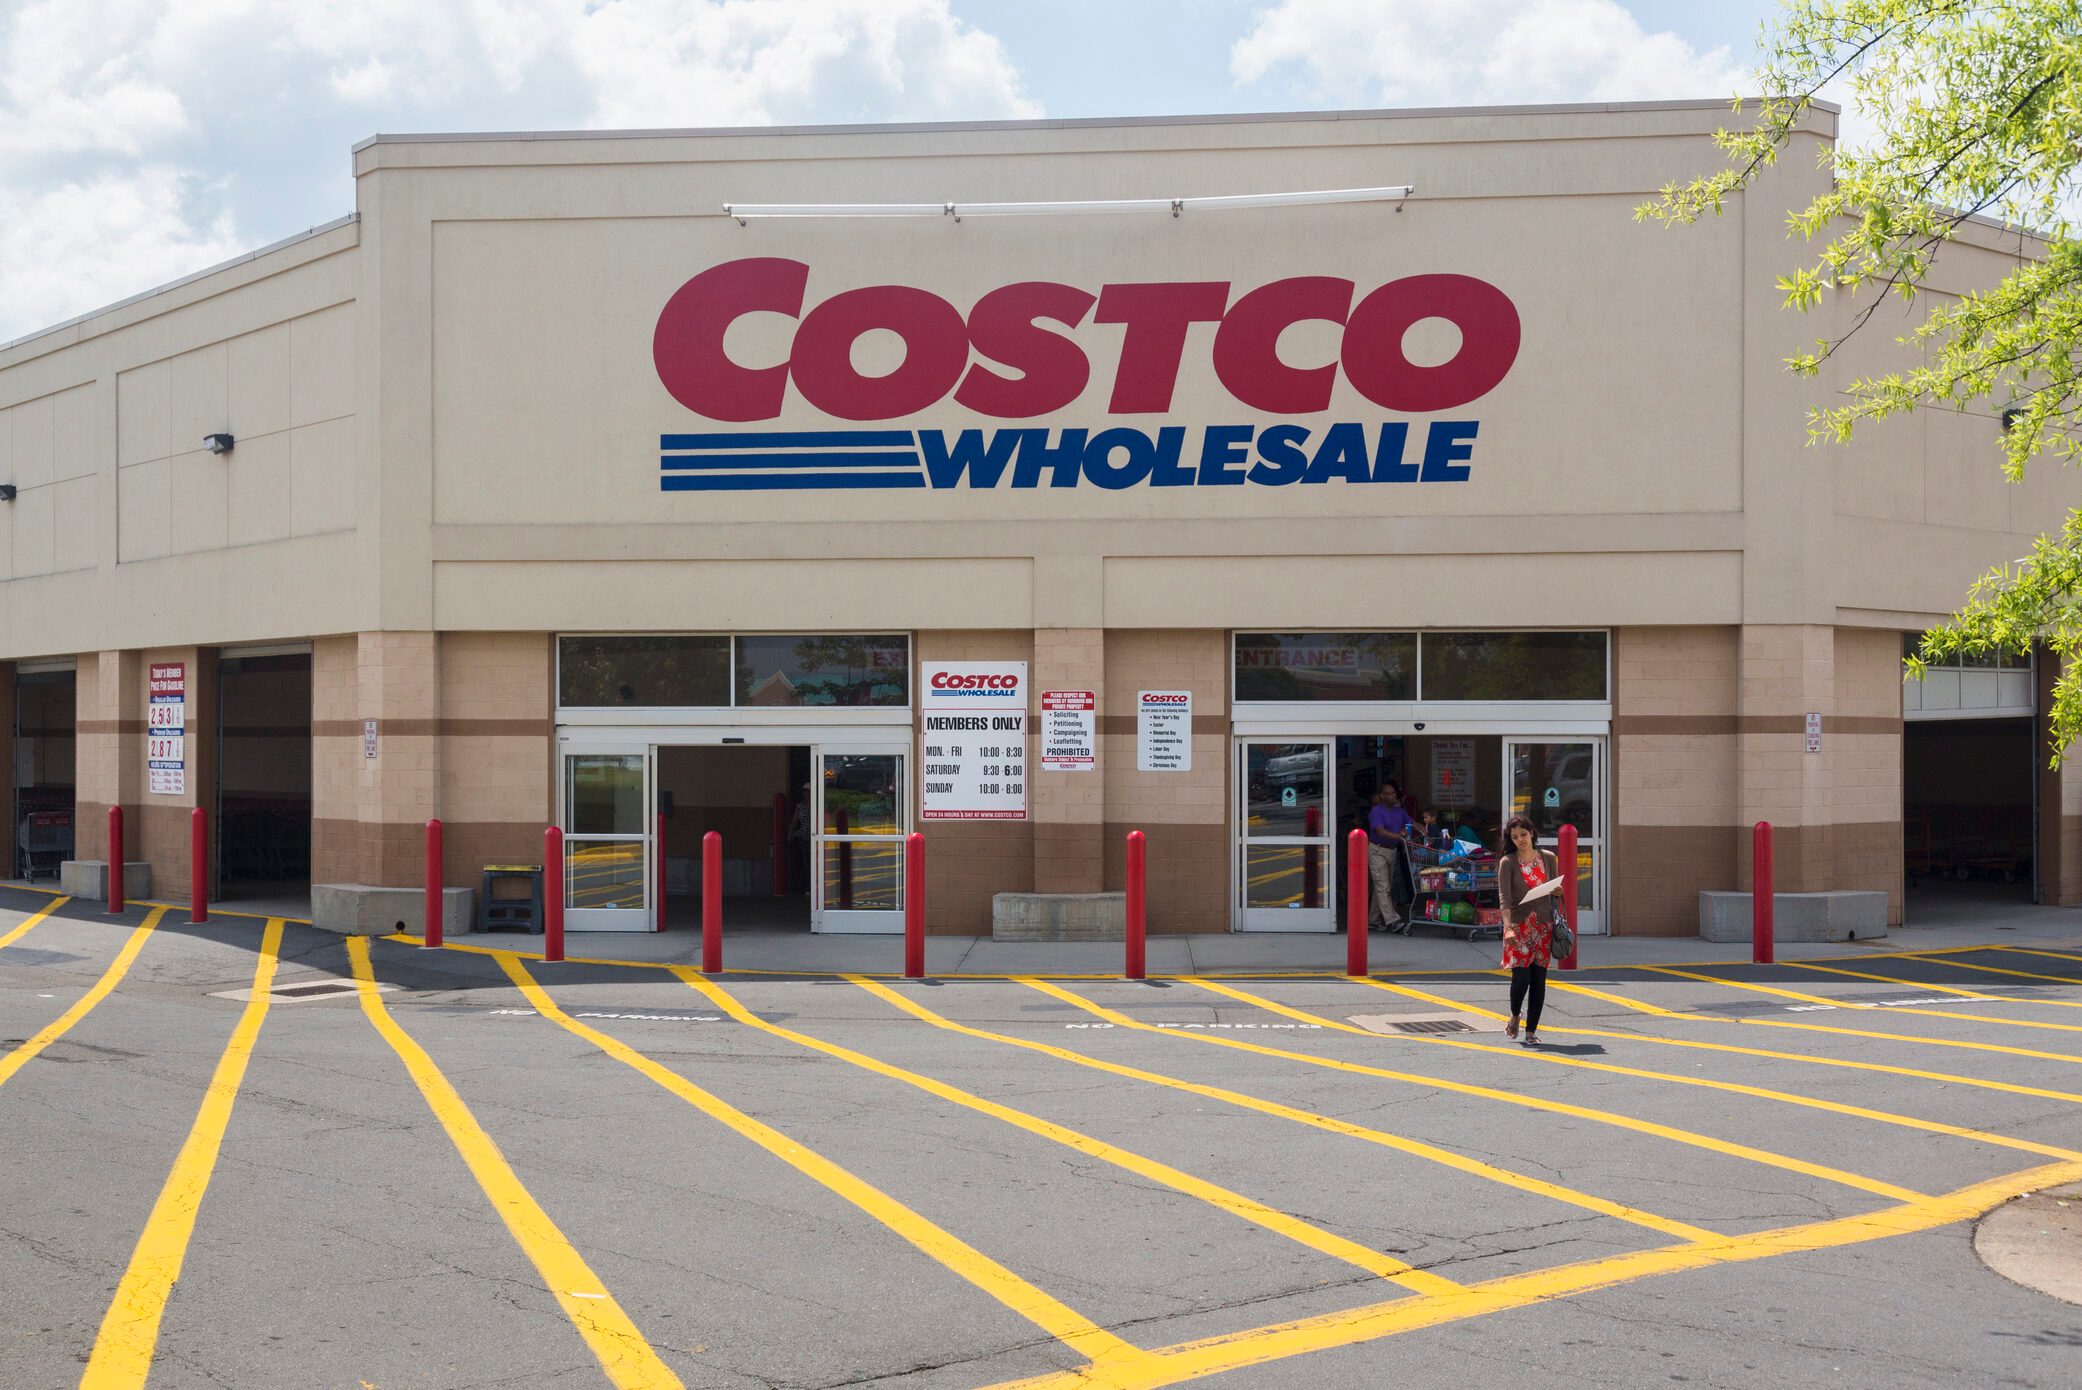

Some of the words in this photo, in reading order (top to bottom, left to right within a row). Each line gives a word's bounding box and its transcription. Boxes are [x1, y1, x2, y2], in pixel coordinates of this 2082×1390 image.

[652, 256, 1521, 422] COSTCO
[913, 420, 1478, 490] WHOLESALE
[931, 672, 1018, 688] COSTCO
[1142, 694, 1188, 702] COSTCO
[926, 717, 988, 730] MEMBERS
[992, 717, 1022, 730] ONLY
[926, 746, 944, 757] MON.
[951, 746, 962, 757] FRI
[979, 747, 1000, 758] 10:00
[1006, 747, 1022, 758] 8:30
[1047, 748, 1090, 756] PROHIBITED
[926, 764, 960, 775] SATURDAY
[983, 765, 1000, 776] 9:30
[926, 783, 953, 794] SUNDAY
[979, 784, 1000, 794] 10:00
[1006, 784, 1022, 794] 6:00
